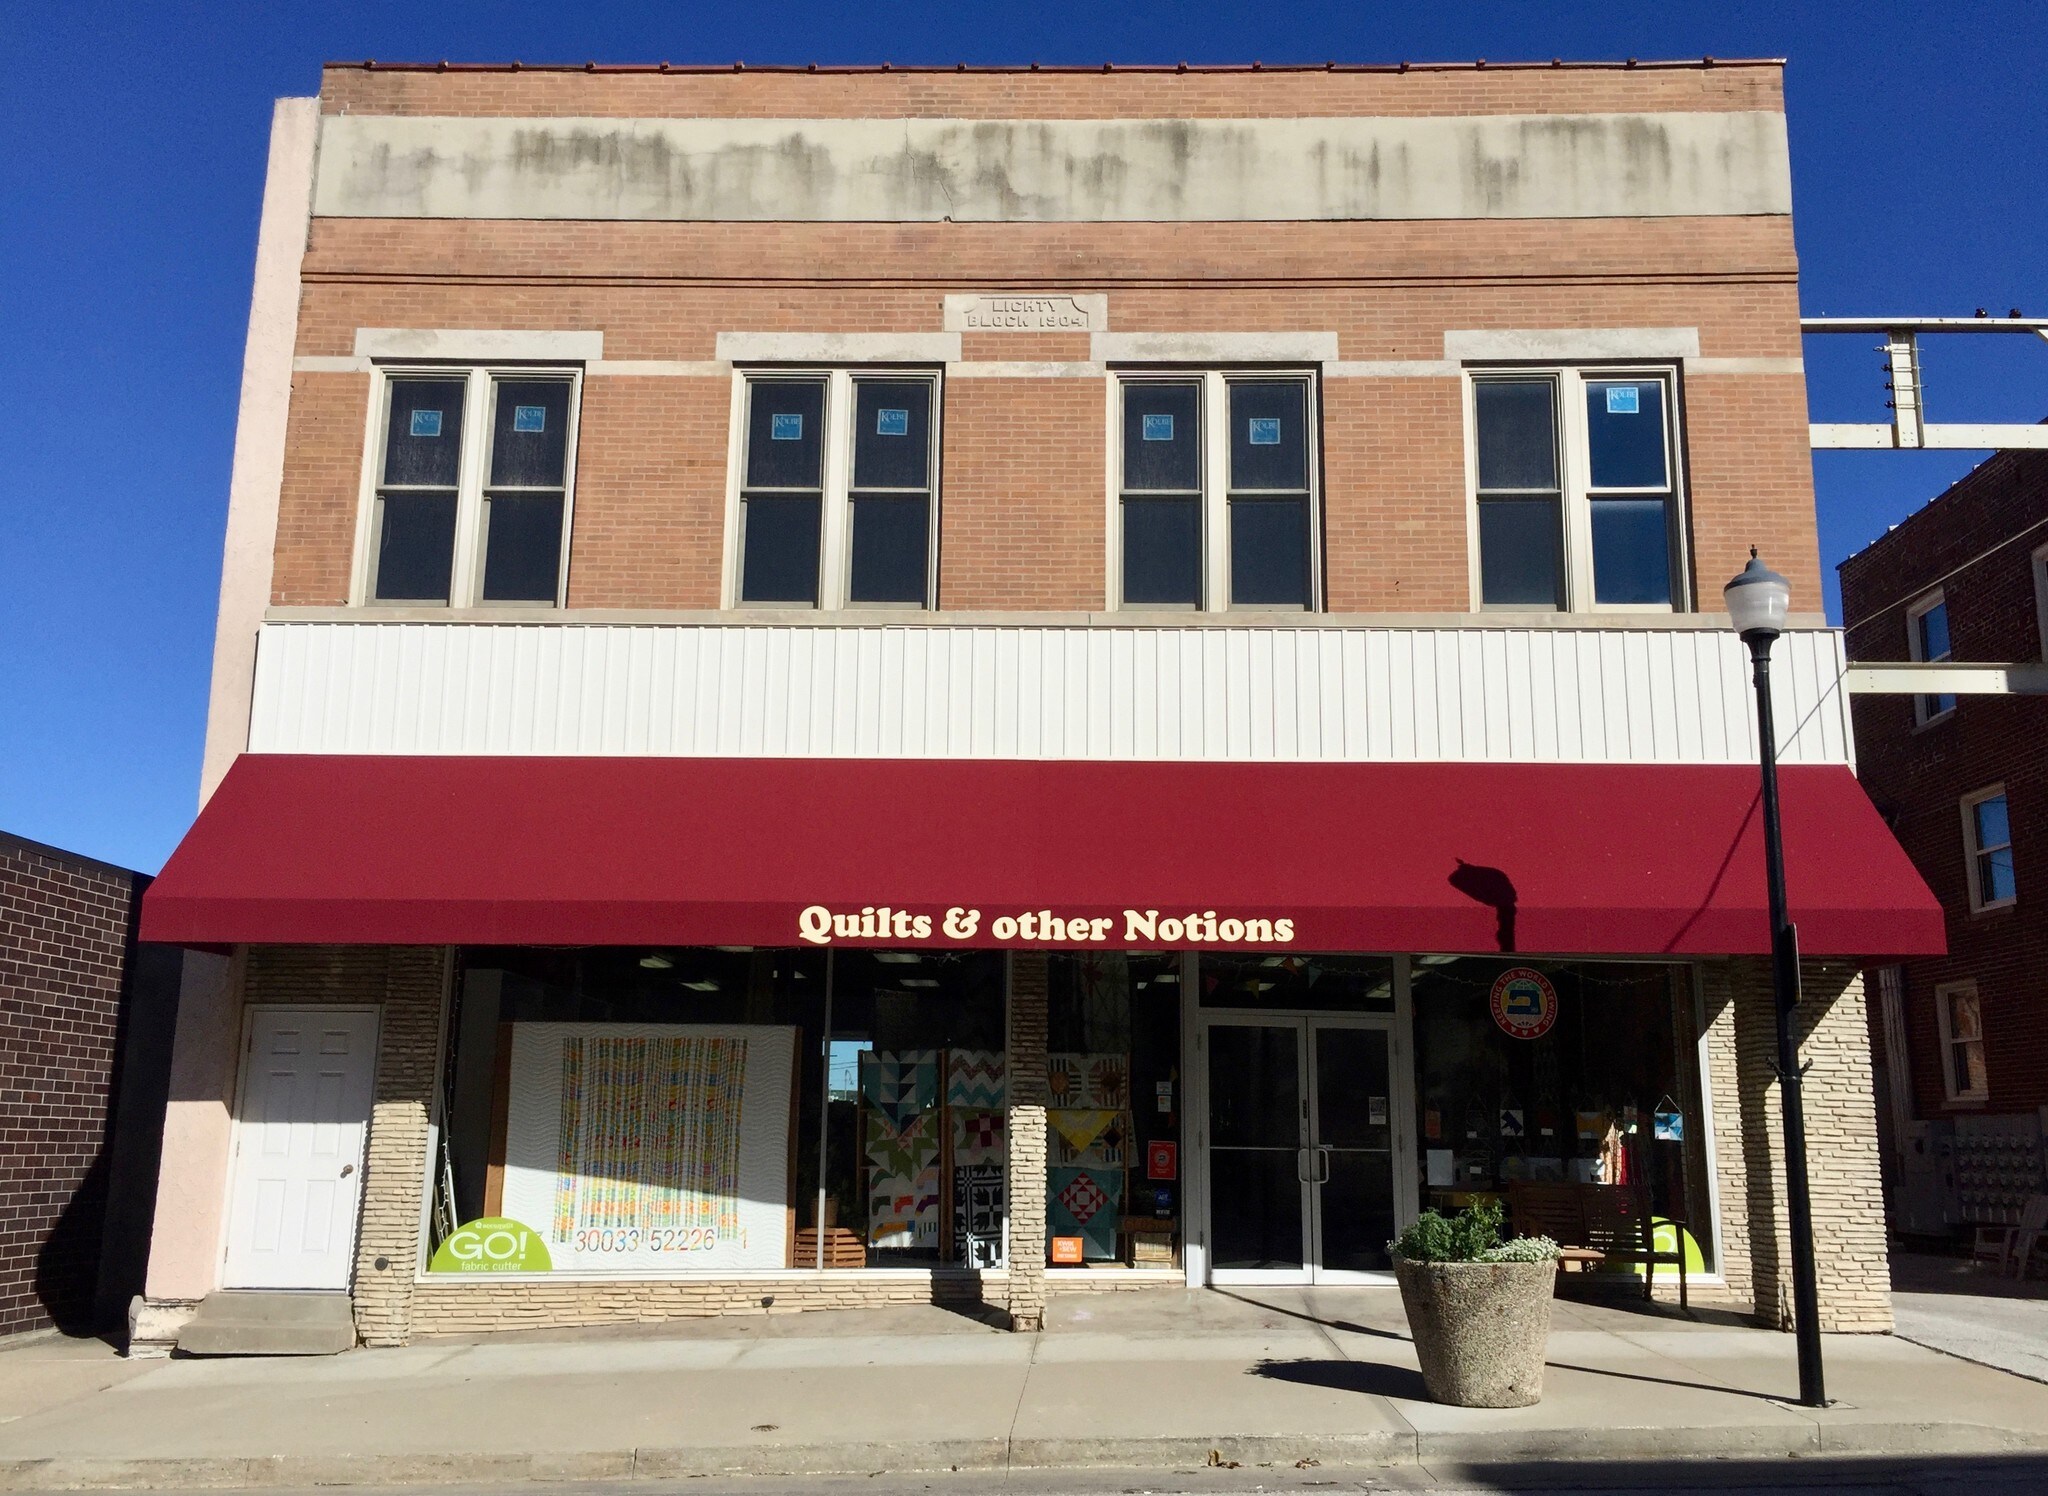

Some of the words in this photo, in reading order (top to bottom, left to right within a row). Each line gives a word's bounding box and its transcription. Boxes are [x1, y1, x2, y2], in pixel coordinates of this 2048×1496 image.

[992, 300, 1056, 313] LICHTY
[967, 315, 1029, 328] BLOCK
[1039, 315, 1084, 328] 1904
[798, 905, 932, 944] Quilts
[942, 906, 981, 939] &
[992, 909, 1113, 941] other
[1123, 909, 1294, 942] Notions
[1492, 985, 1507, 1025] KEEPING
[1500, 972, 1517, 985] THE
[1519, 970, 1548, 989] WORLD
[1542, 990, 1555, 1027] SEWING
[449, 1231, 528, 1259] GO!
[575, 1229, 639, 1252] 30033
[650, 1228, 715, 1251] 52226
[461, 1262, 489, 1271] fabric
[492, 1262, 522, 1271] cutter
